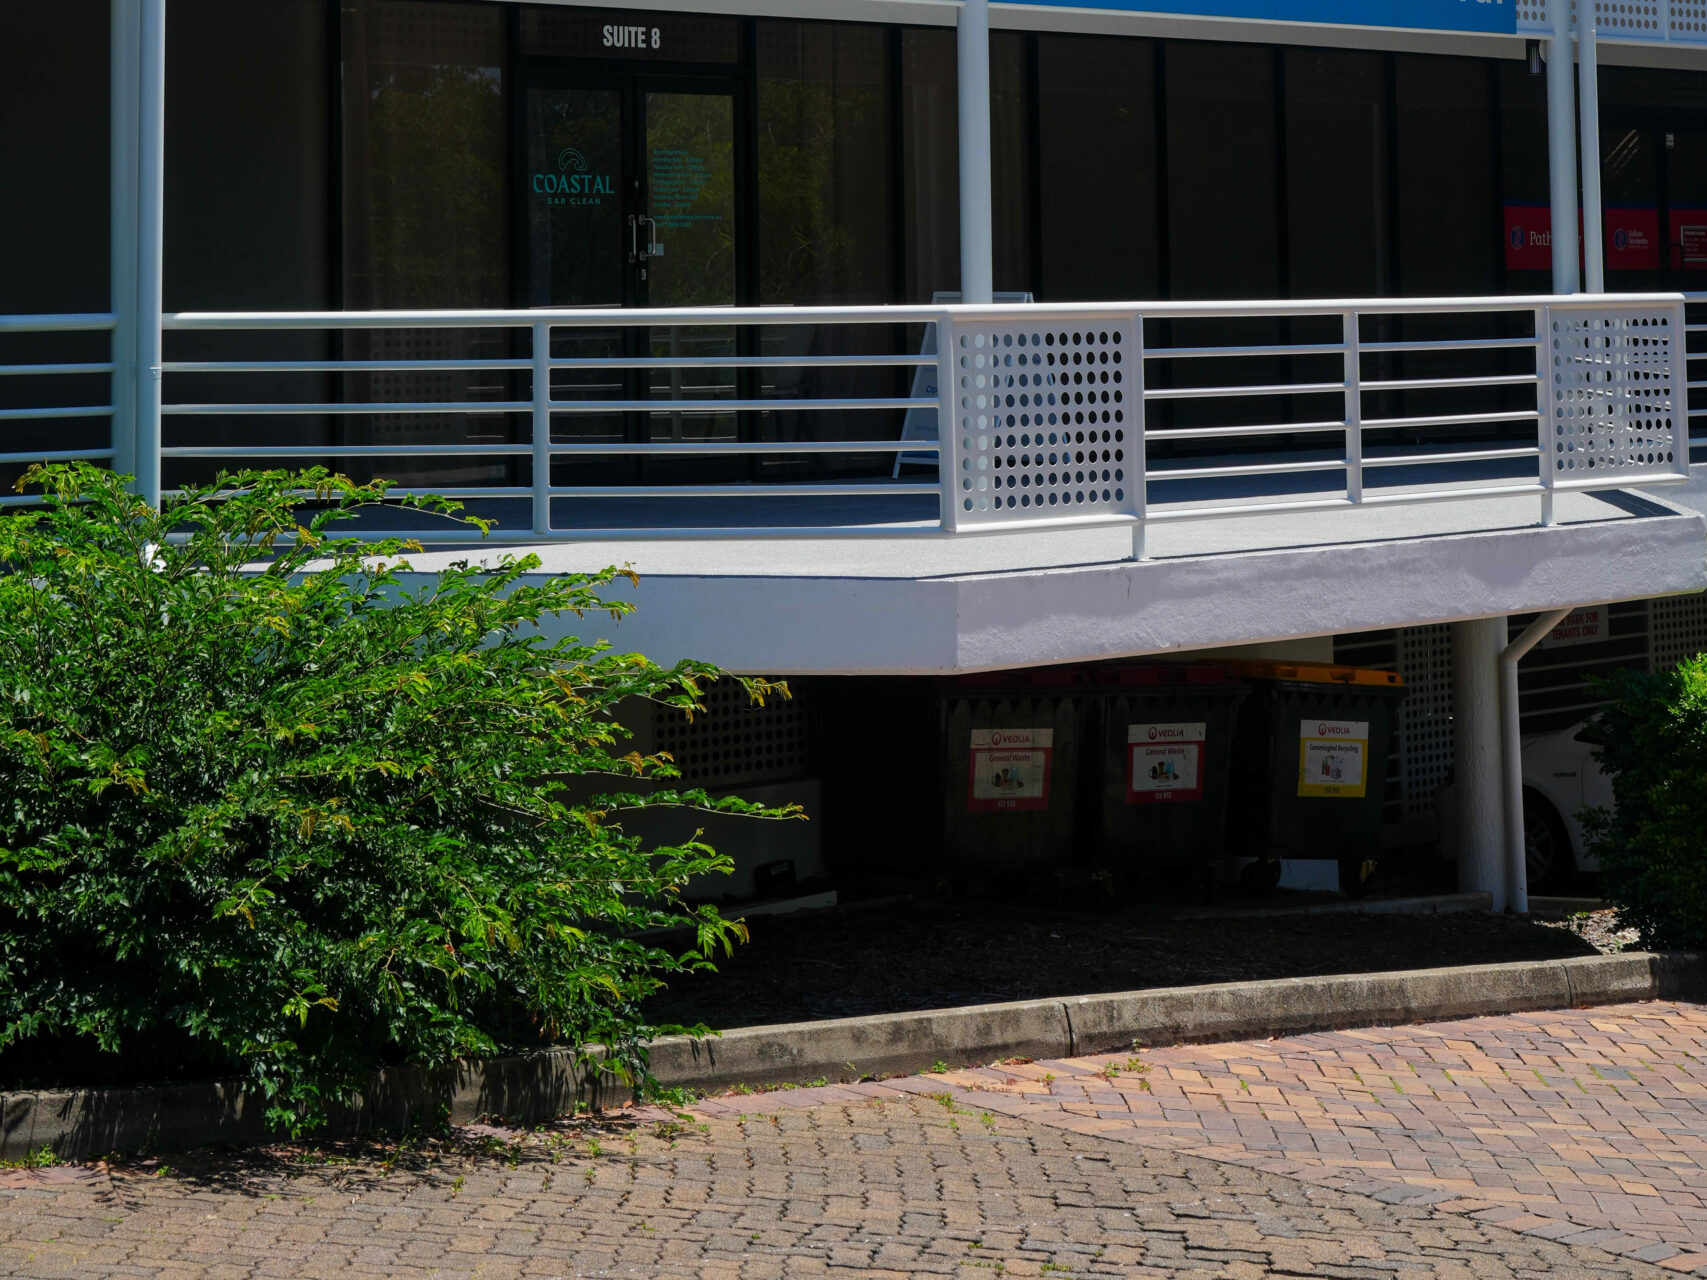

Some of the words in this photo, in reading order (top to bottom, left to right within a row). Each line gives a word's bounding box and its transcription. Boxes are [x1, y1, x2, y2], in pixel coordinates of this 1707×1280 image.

[602, 24, 647, 49] SUITE
[650, 27, 661, 50] 8
[532, 173, 615, 194] COASTAL
[547, 197, 566, 205] EAR
[569, 197, 601, 205] CLEAN
[1567, 613, 1585, 626] PARK
[1585, 611, 1599, 623] FOR
[1552, 626, 1581, 640] TENANTS
[1582, 623, 1599, 637] ONLY
[1158, 729, 1184, 737] VEOLIA
[1327, 726, 1350, 735] VEOLIA
[1003, 735, 1030, 743] VEOLIA
[1145, 748, 1167, 756] General
[1167, 747, 1185, 755] Waste
[989, 754, 1012, 762] General
